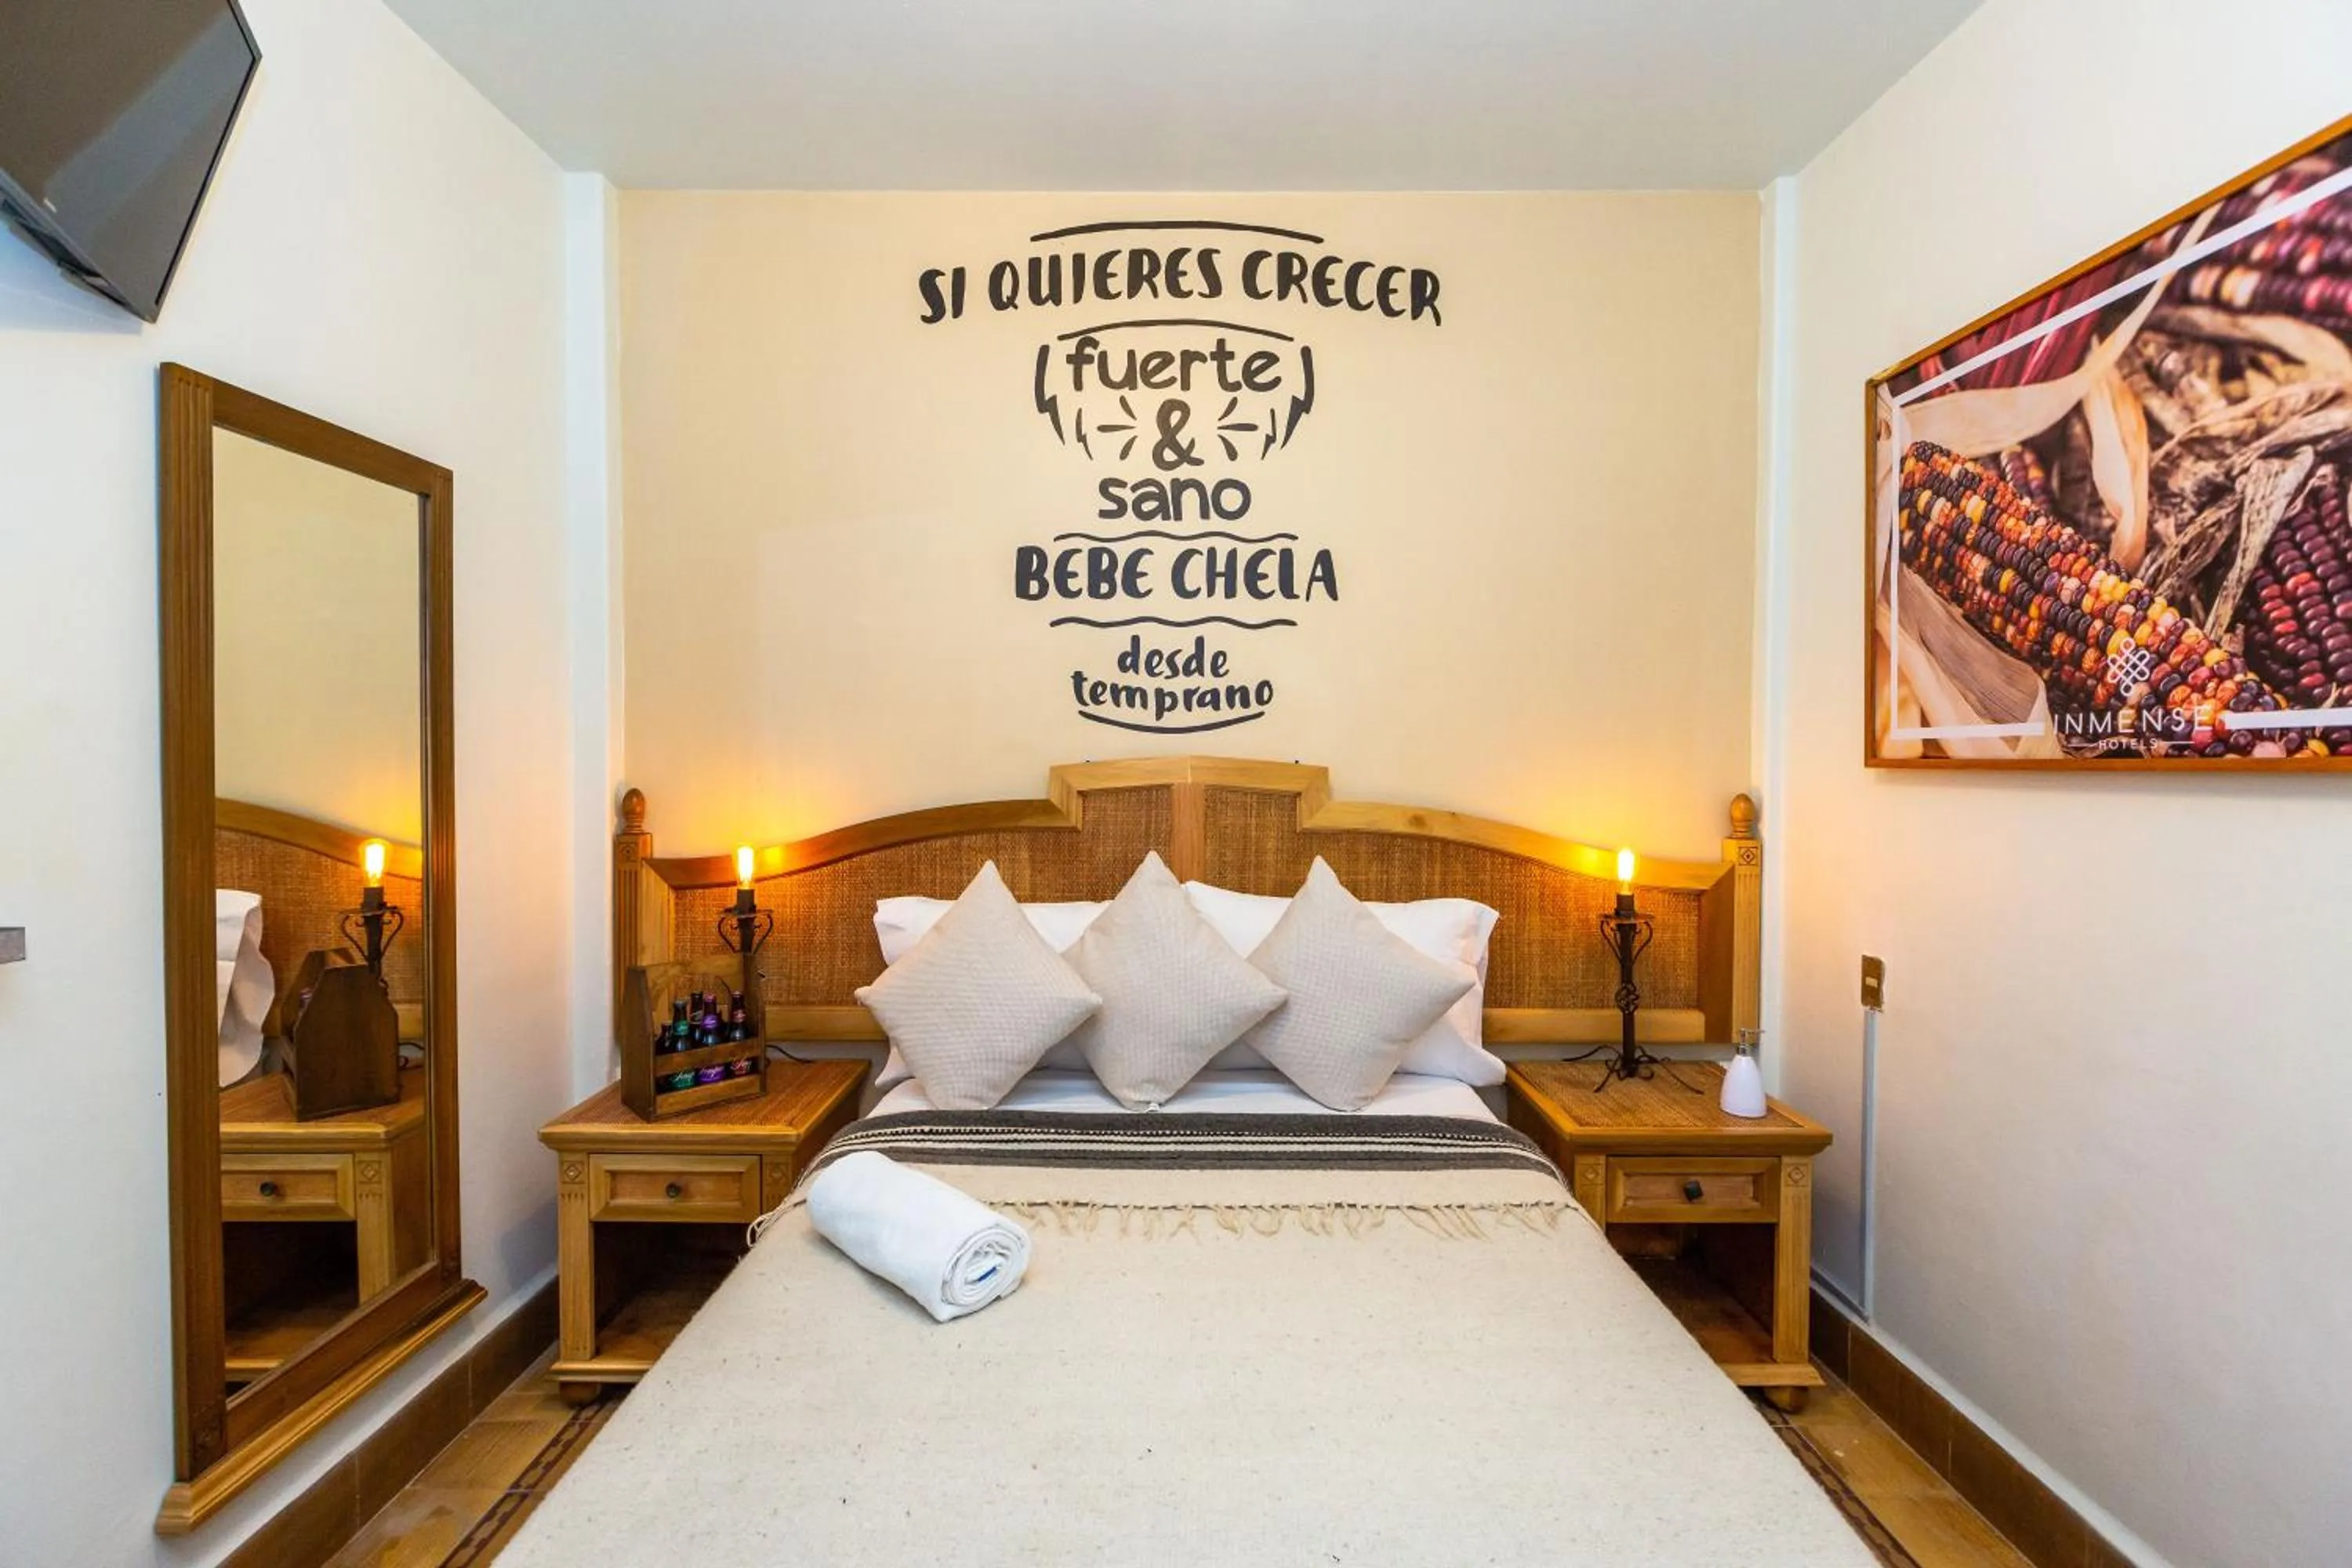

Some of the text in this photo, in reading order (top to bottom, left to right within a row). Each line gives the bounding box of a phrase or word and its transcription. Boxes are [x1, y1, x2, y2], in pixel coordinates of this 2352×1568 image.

[918, 247, 1443, 327] SI QUIERES CRECER
[1065, 335, 1283, 393] fuerte
[1152, 398, 1205, 471] &
[1098, 477, 1252, 521] sano
[1014, 545, 1340, 602] BEBE CHELA
[1117, 634, 1230, 680] desde
[1070, 670, 1275, 721] temprano
[2053, 705, 2213, 735] INMENSE
[2098, 738, 2158, 750] HOTELS
